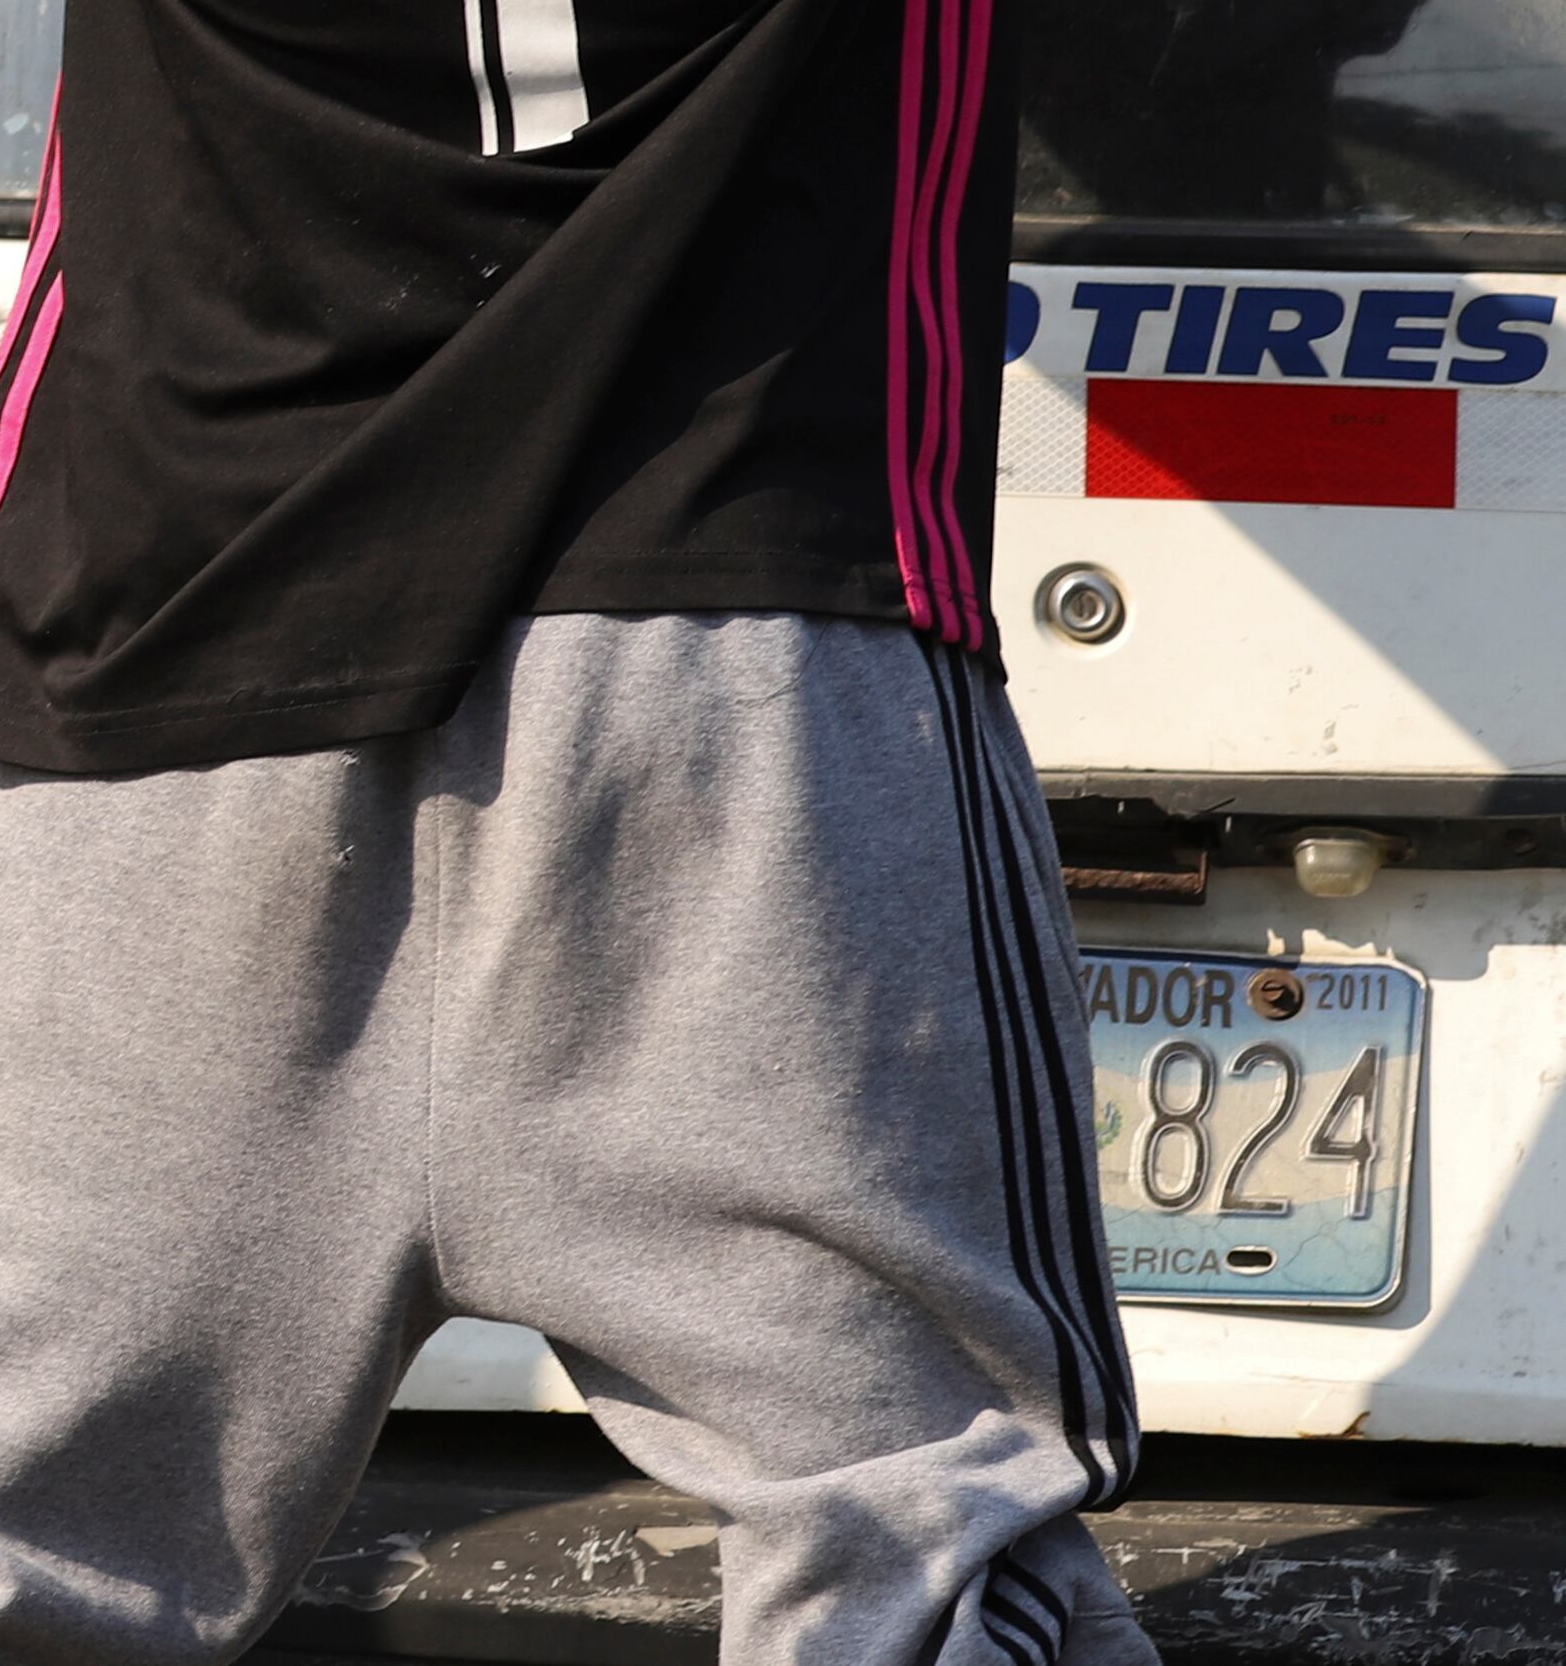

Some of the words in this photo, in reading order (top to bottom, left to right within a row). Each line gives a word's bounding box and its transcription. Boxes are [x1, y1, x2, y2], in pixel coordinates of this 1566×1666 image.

[1072, 281, 1557, 385] TIRES
[1318, 974, 1388, 1011] 2011
[1138, 1038, 1378, 1219] 824
[1108, 1246, 1221, 1275] ERICA
